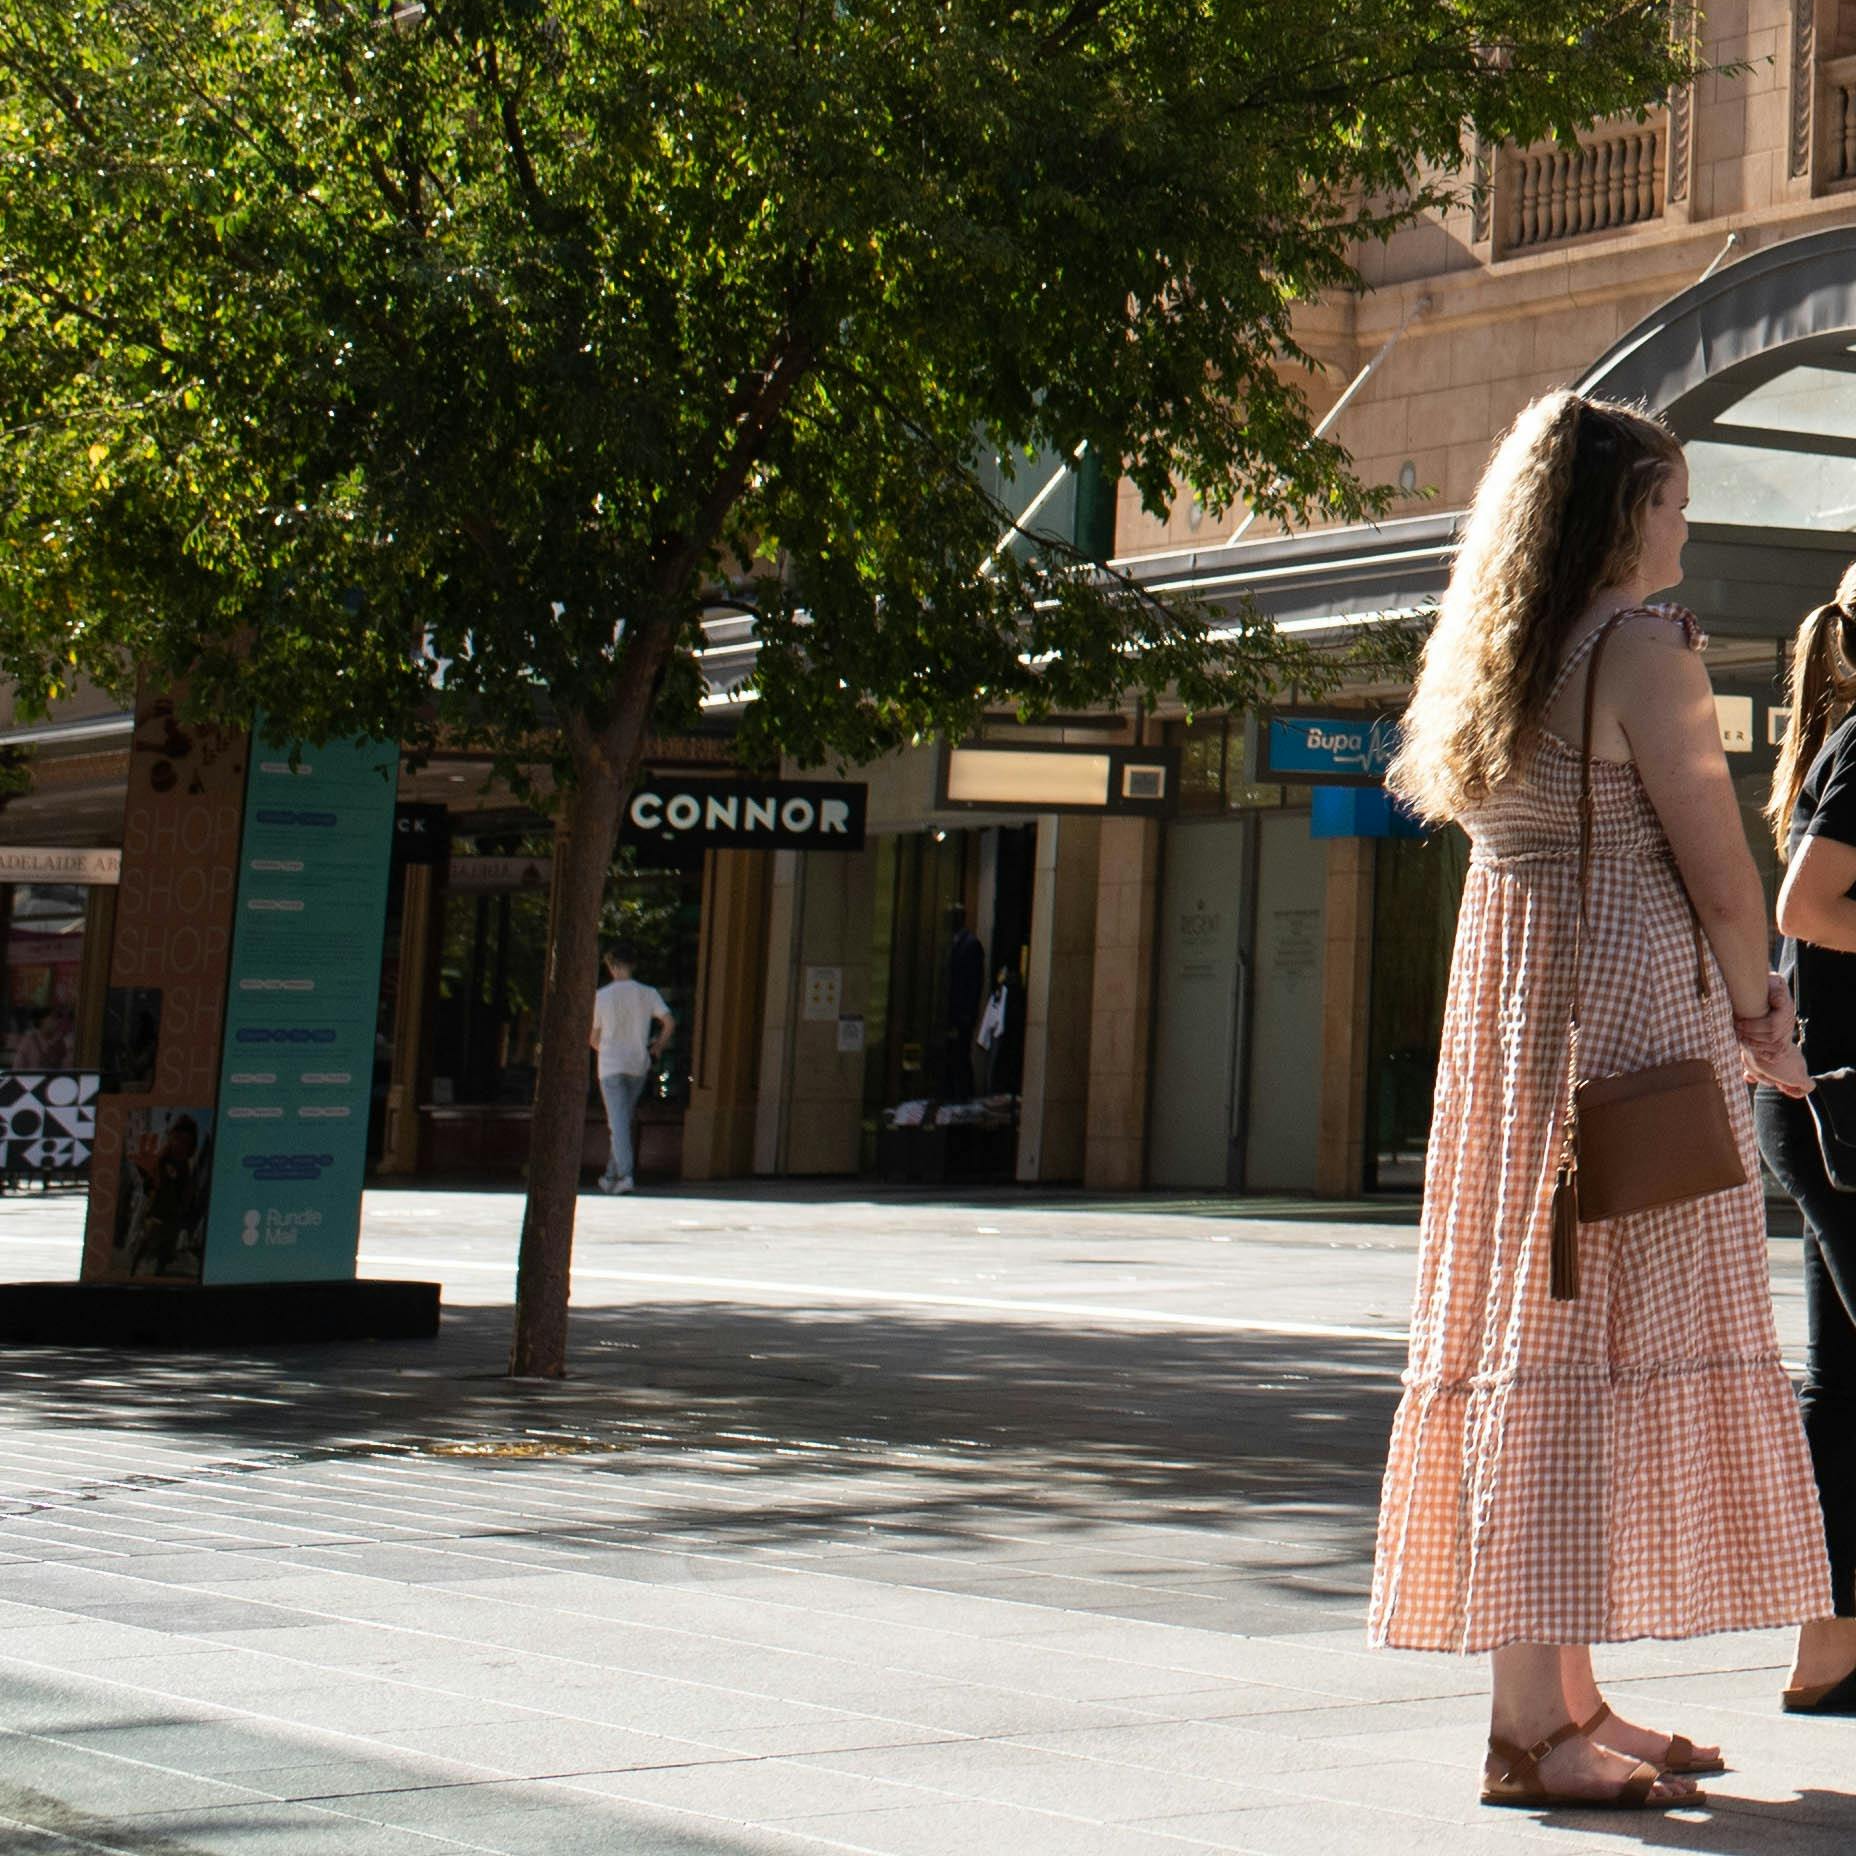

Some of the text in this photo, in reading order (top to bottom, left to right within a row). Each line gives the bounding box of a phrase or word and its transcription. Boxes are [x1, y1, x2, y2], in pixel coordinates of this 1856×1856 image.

[1306, 727, 1362, 753] Bupa
[127, 805, 241, 856] SHOP
[629, 792, 849, 834] CONNOR
[120, 865, 235, 916] SHOP
[114, 925, 228, 976] SHOP
